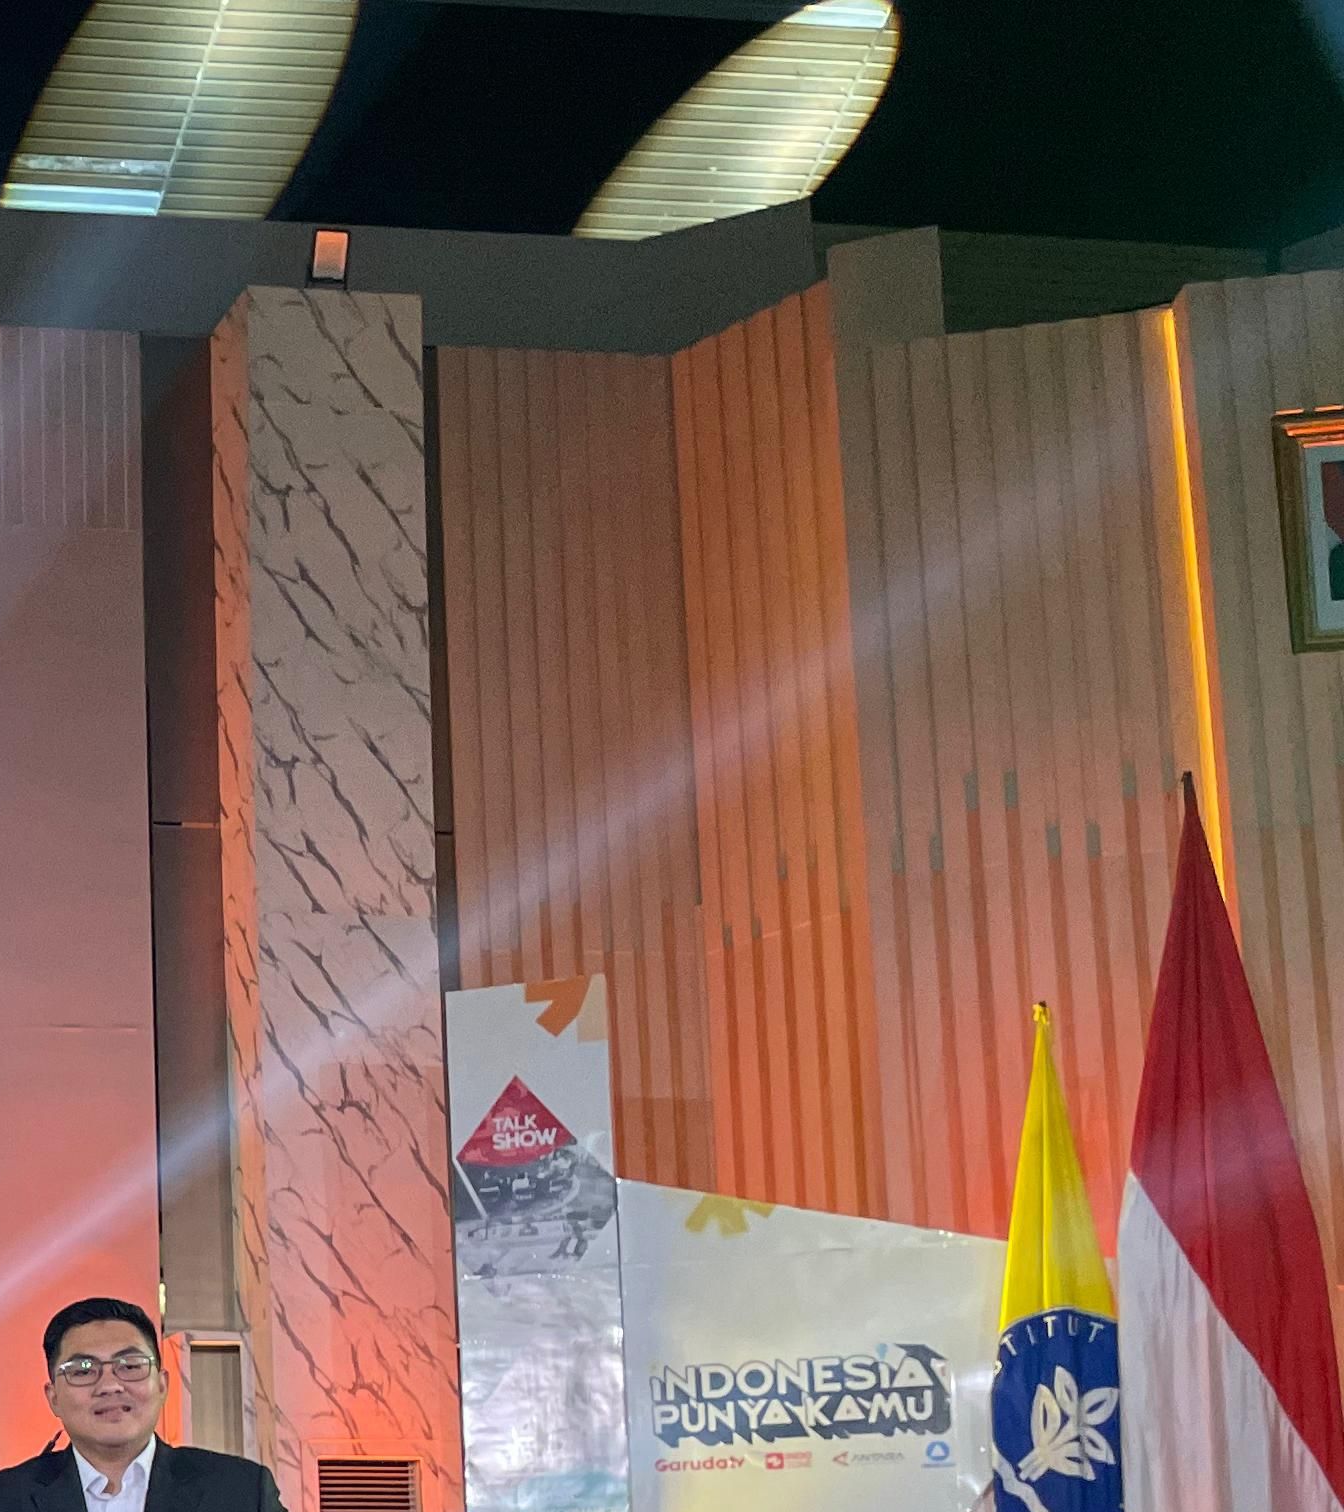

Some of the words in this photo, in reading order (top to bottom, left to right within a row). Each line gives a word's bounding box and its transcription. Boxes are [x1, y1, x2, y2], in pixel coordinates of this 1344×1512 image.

[492, 1114, 538, 1132] TALK
[492, 1127, 558, 1150] SHOW
[650, 1354, 935, 1402] INDONESIA
